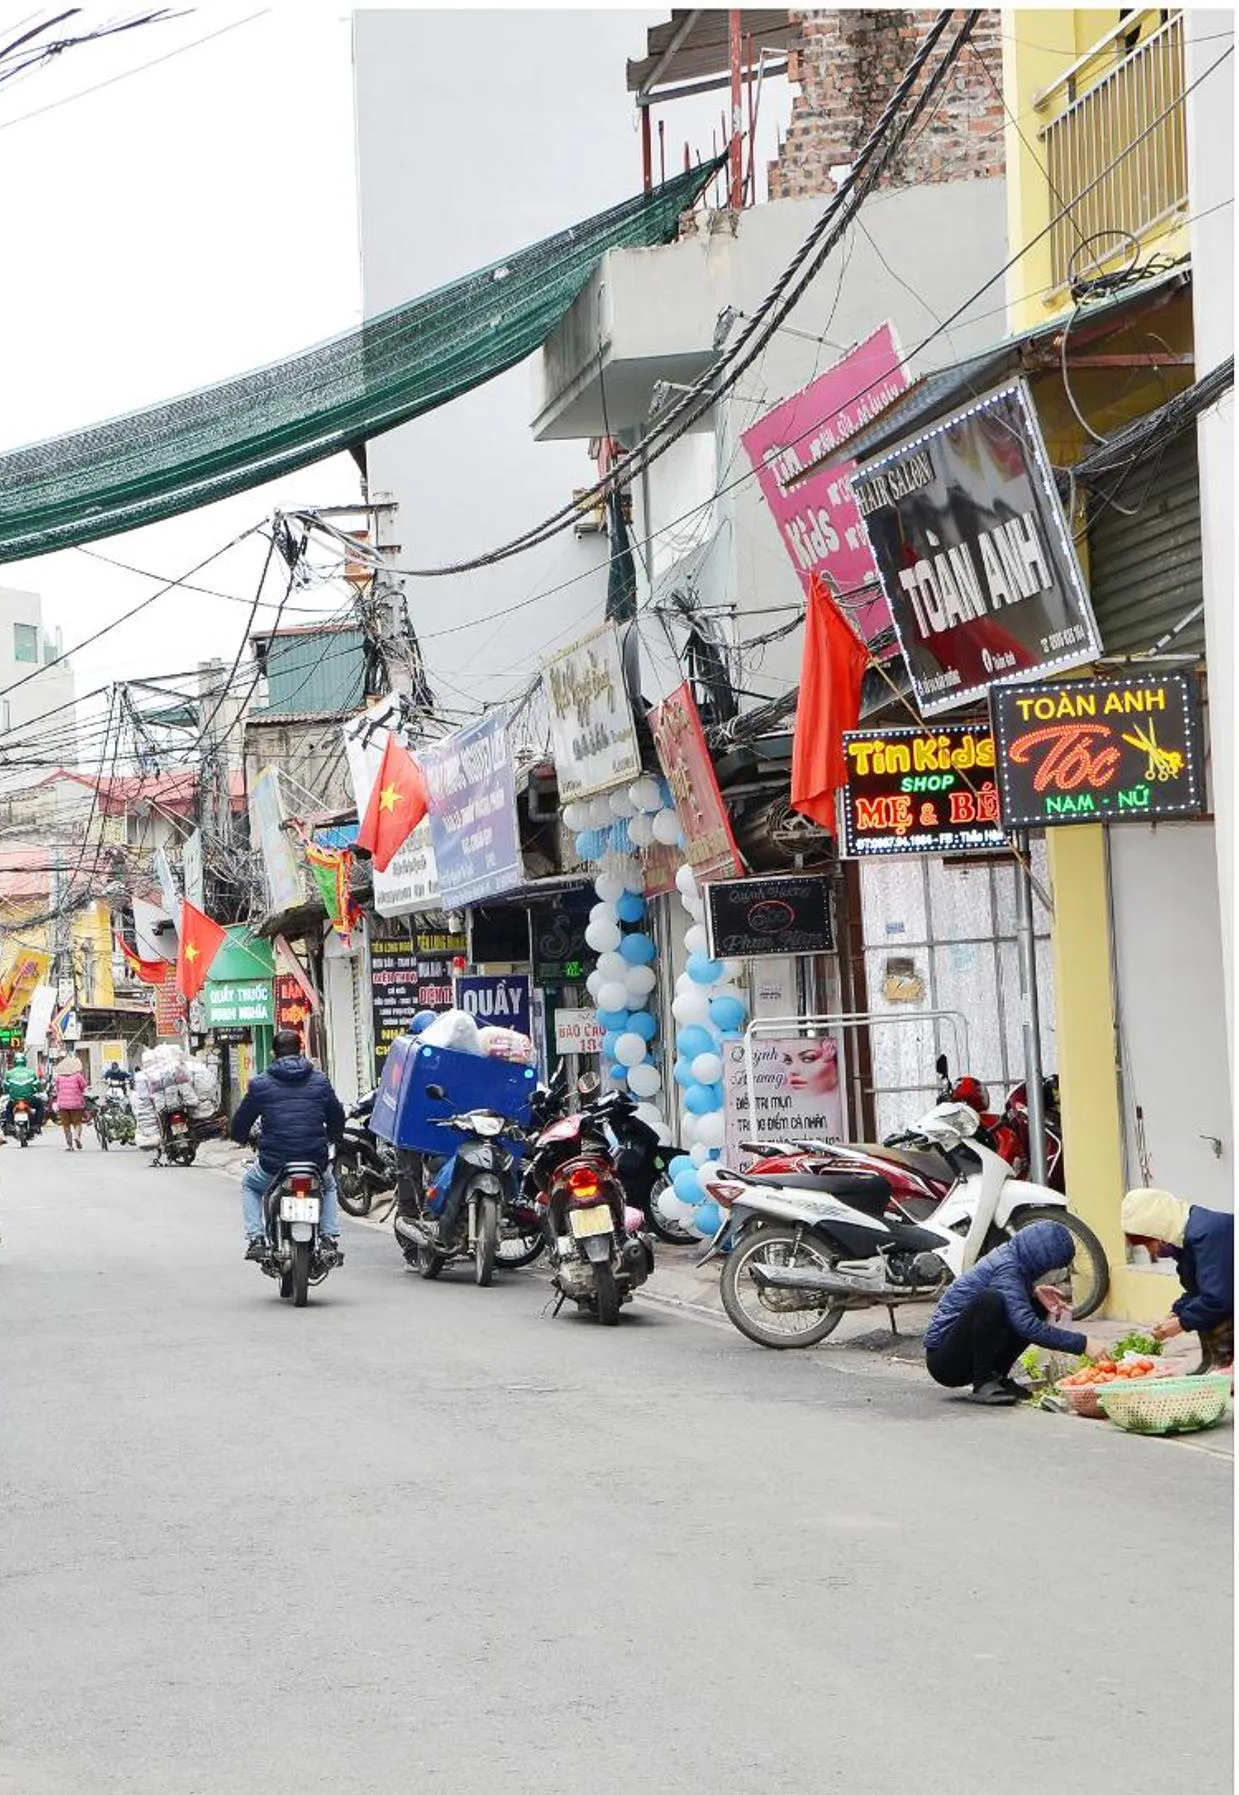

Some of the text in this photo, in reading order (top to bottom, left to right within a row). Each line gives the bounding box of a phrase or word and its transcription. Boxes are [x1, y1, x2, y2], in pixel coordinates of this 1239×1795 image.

[857, 473, 893, 517] HAIR
[888, 450, 938, 501] SALON
[785, 507, 840, 570] Kids
[898, 529, 989, 639] TOÀN
[977, 510, 1054, 610] ANH
[1016, 689, 1166, 722] TOÀN ANH
[901, 775, 954, 792] SHOP
[1009, 724, 1120, 792] Tóc
[855, 782, 999, 835] MẸ & BÉ
[1045, 795, 1094, 813] NAM
[1118, 786, 1150, 808] NỮ
[463, 980, 523, 1017] QUẦY
